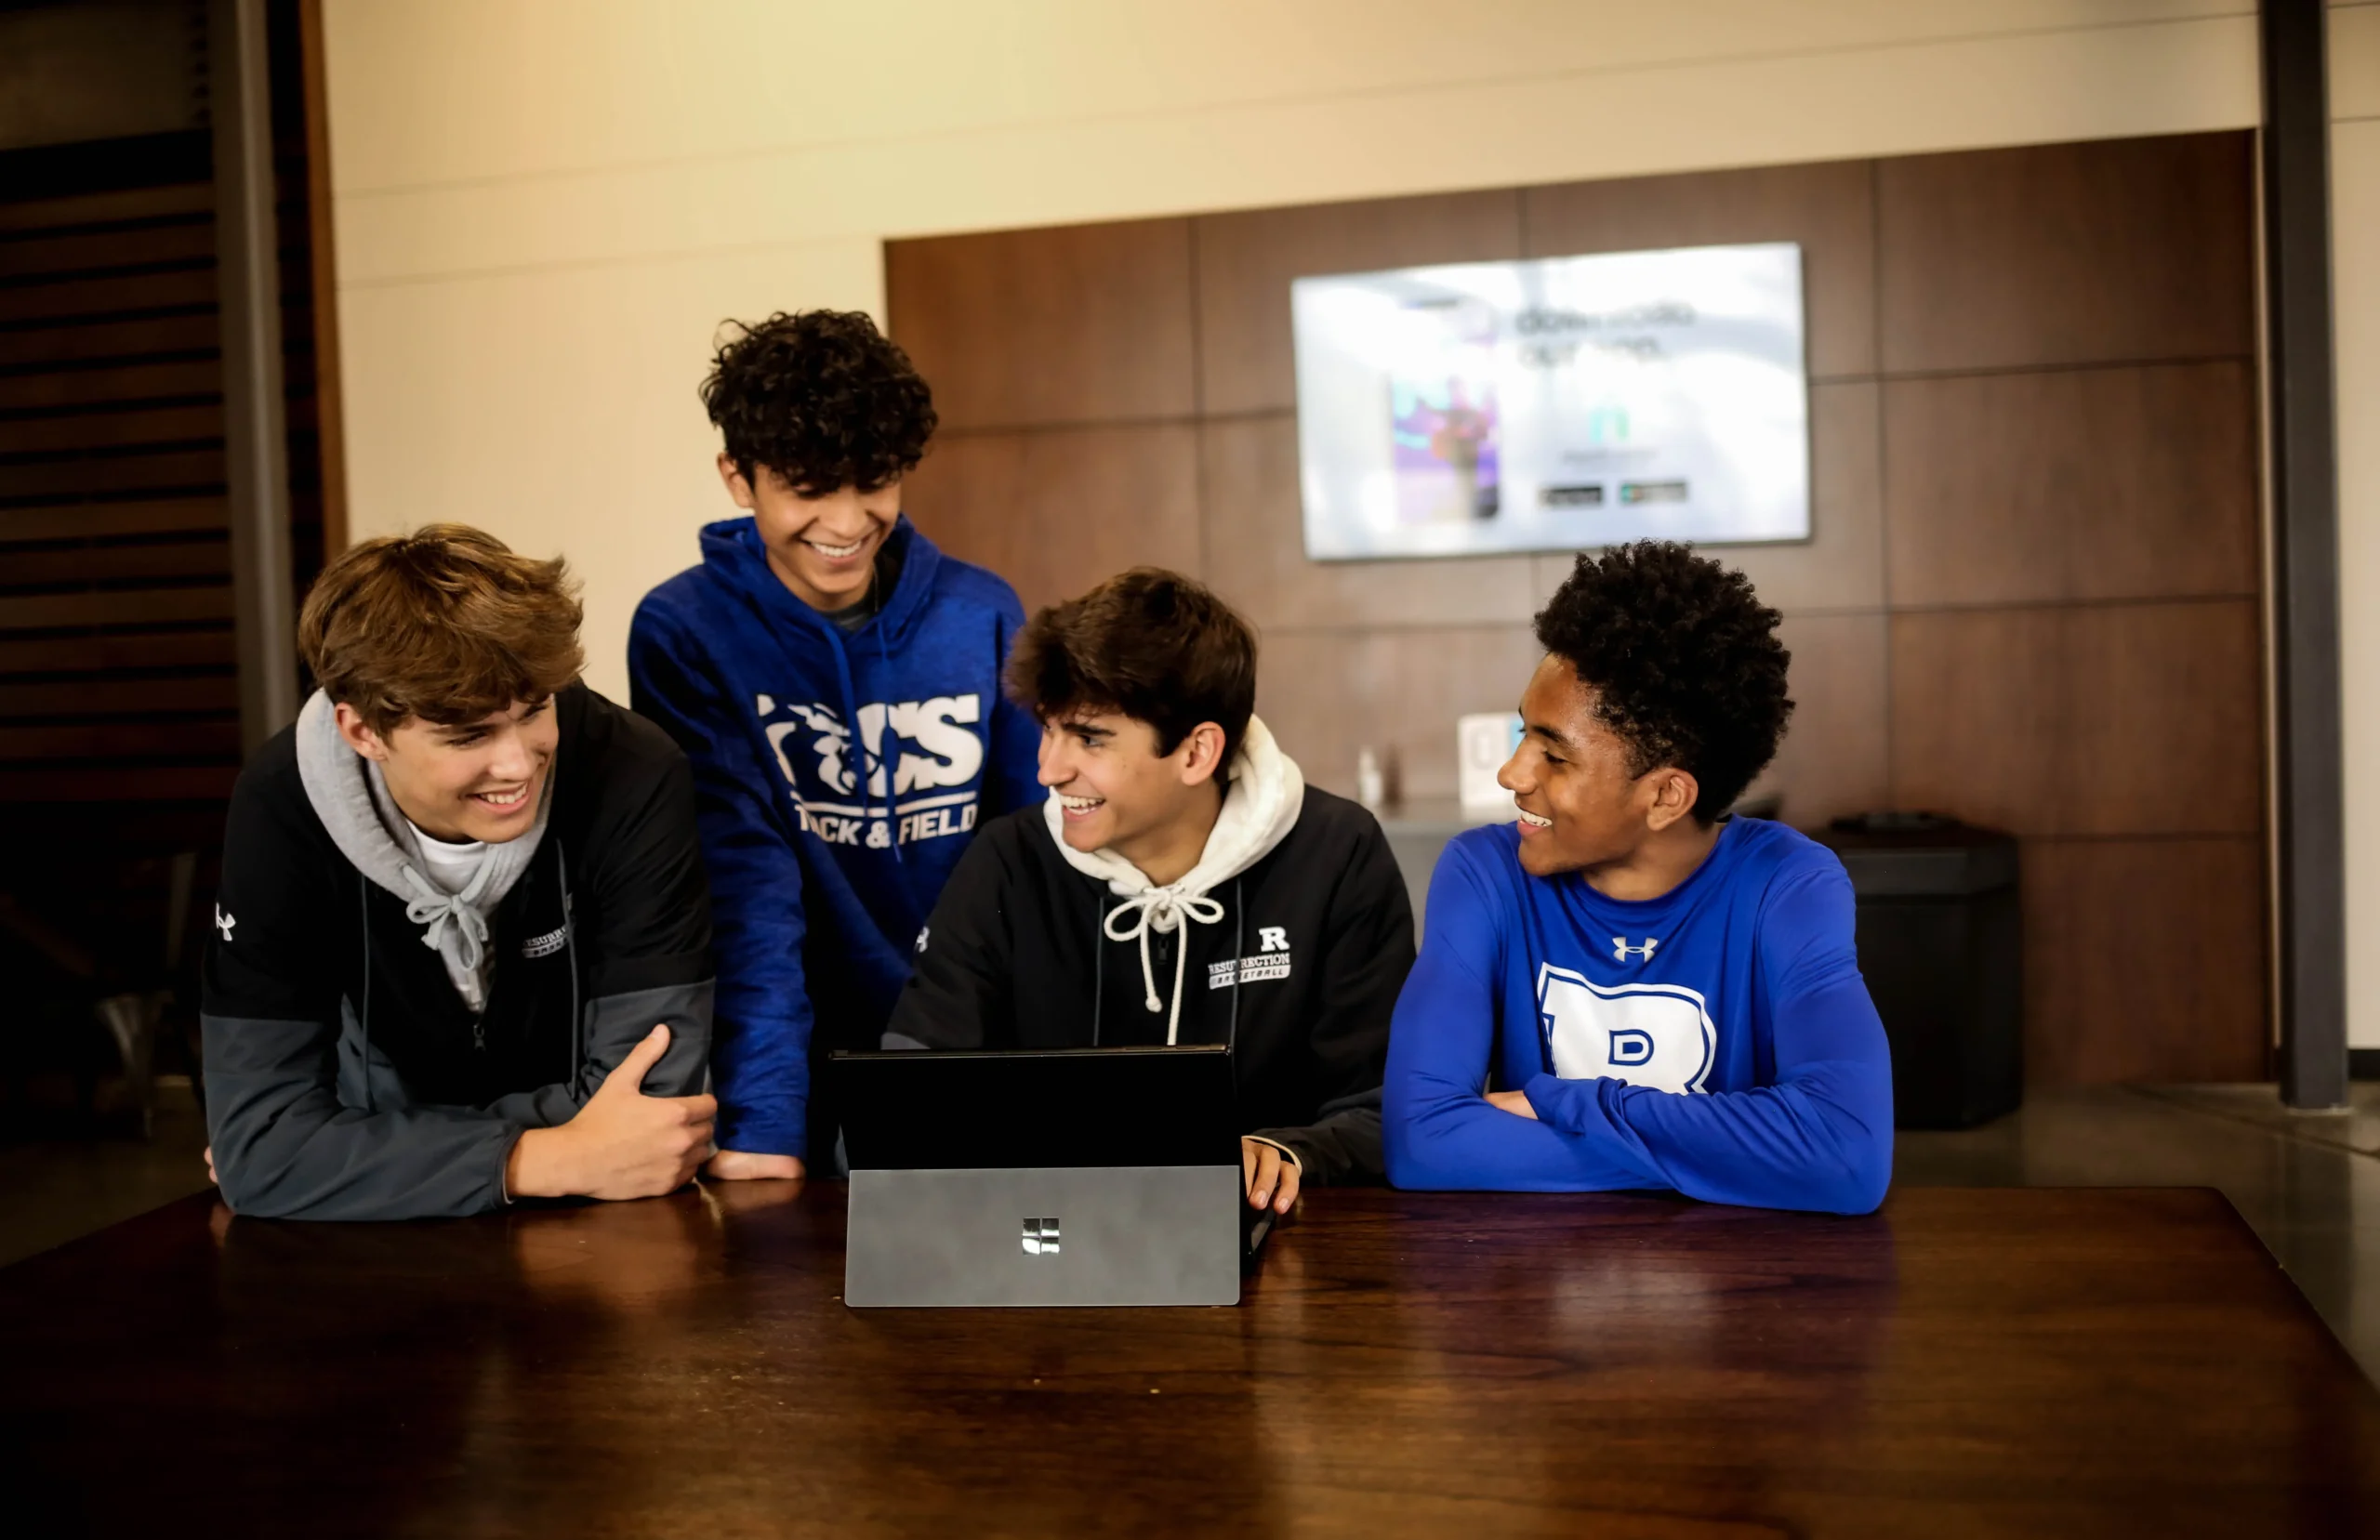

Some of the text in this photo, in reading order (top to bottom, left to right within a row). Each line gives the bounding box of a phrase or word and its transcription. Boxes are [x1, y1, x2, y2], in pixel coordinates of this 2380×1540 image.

[794, 803, 978, 849] TCK & FIELD
[1258, 926, 1290, 952] R
[1208, 952, 1290, 977] RESURECTION
